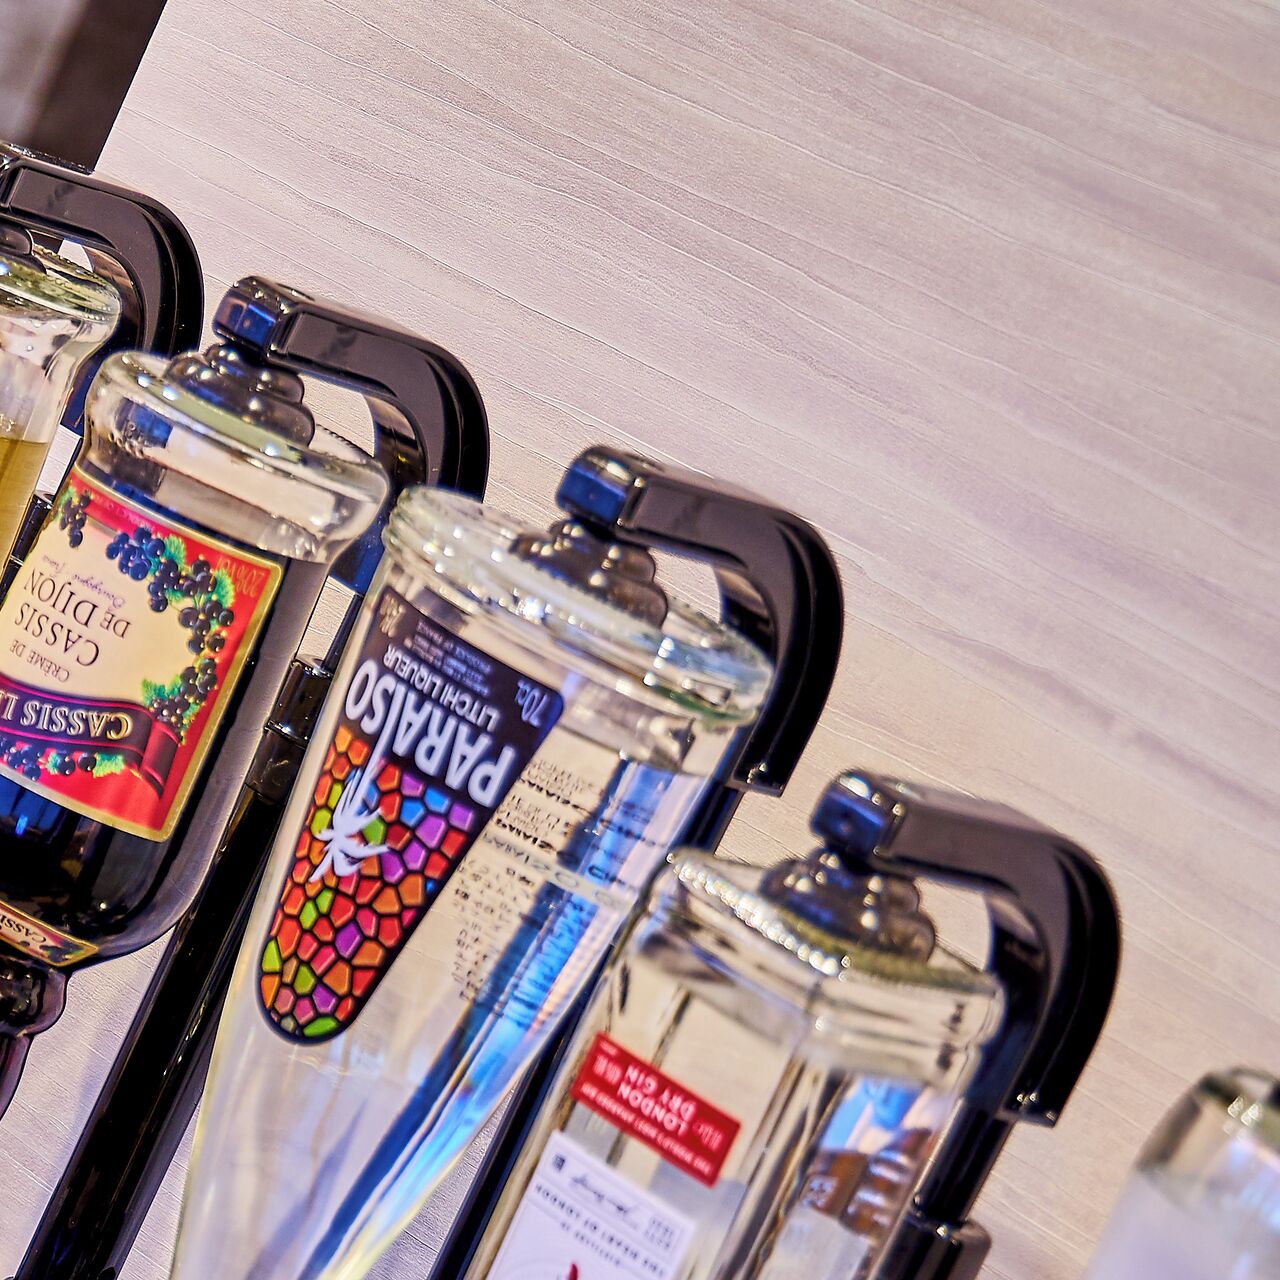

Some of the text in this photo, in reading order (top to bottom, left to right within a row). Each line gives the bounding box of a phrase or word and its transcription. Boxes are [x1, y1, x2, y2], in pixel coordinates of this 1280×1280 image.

[20, 567, 131, 639] DE DIJON
[7, 638, 71, 683] CRÈME DE
[12, 600, 103, 669] CASSIS
[381, 642, 443, 698] LIQUEUR
[17, 699, 134, 737] CASSIS
[351, 658, 517, 809] PARAISO
[437, 681, 501, 733] LITCHI
[621, 1062, 661, 1096] GIN
[656, 1084, 699, 1121] DRY
[615, 1080, 689, 1137] LONDON
